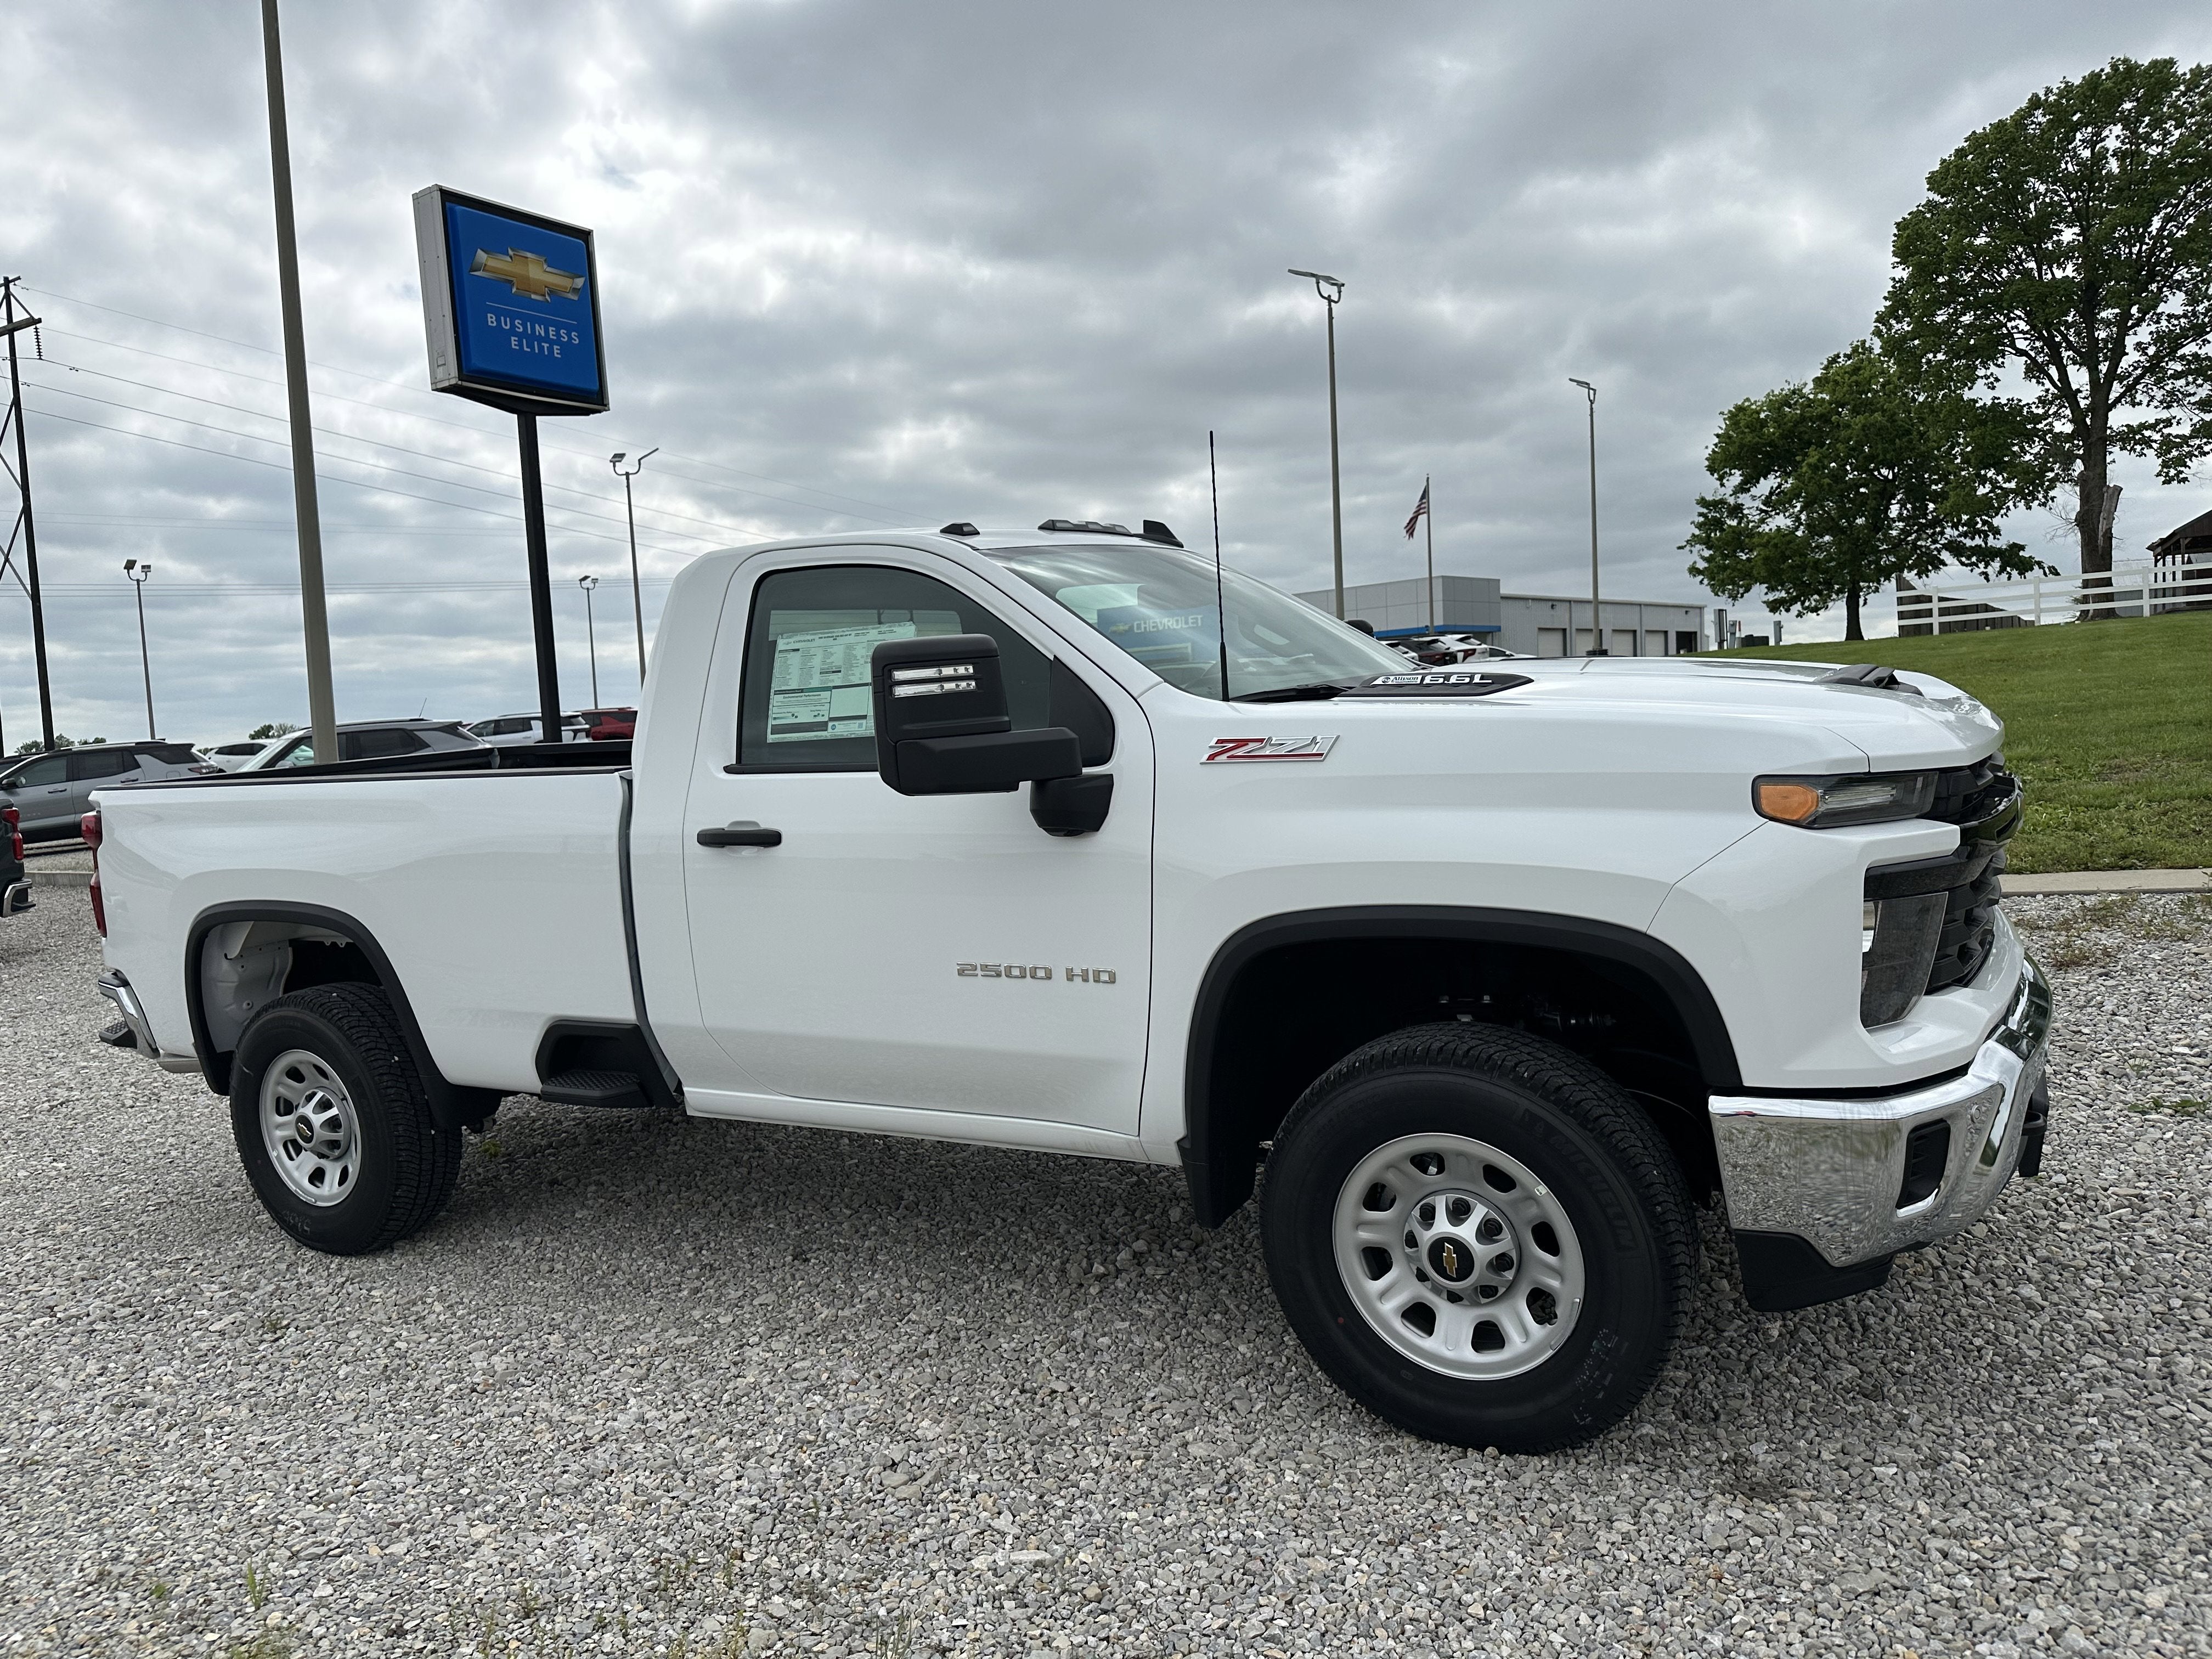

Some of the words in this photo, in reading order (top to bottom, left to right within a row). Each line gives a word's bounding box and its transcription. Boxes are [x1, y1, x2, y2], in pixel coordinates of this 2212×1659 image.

[487, 313, 580, 344] BUSINESS
[511, 336, 562, 358] ELITE
[1134, 615, 1203, 633] CHEVROLET
[1423, 674, 1494, 684] 6.6L
[1199, 735, 1340, 764] Z71
[956, 961, 1053, 980] 2500
[1065, 966, 1116, 984] HD
